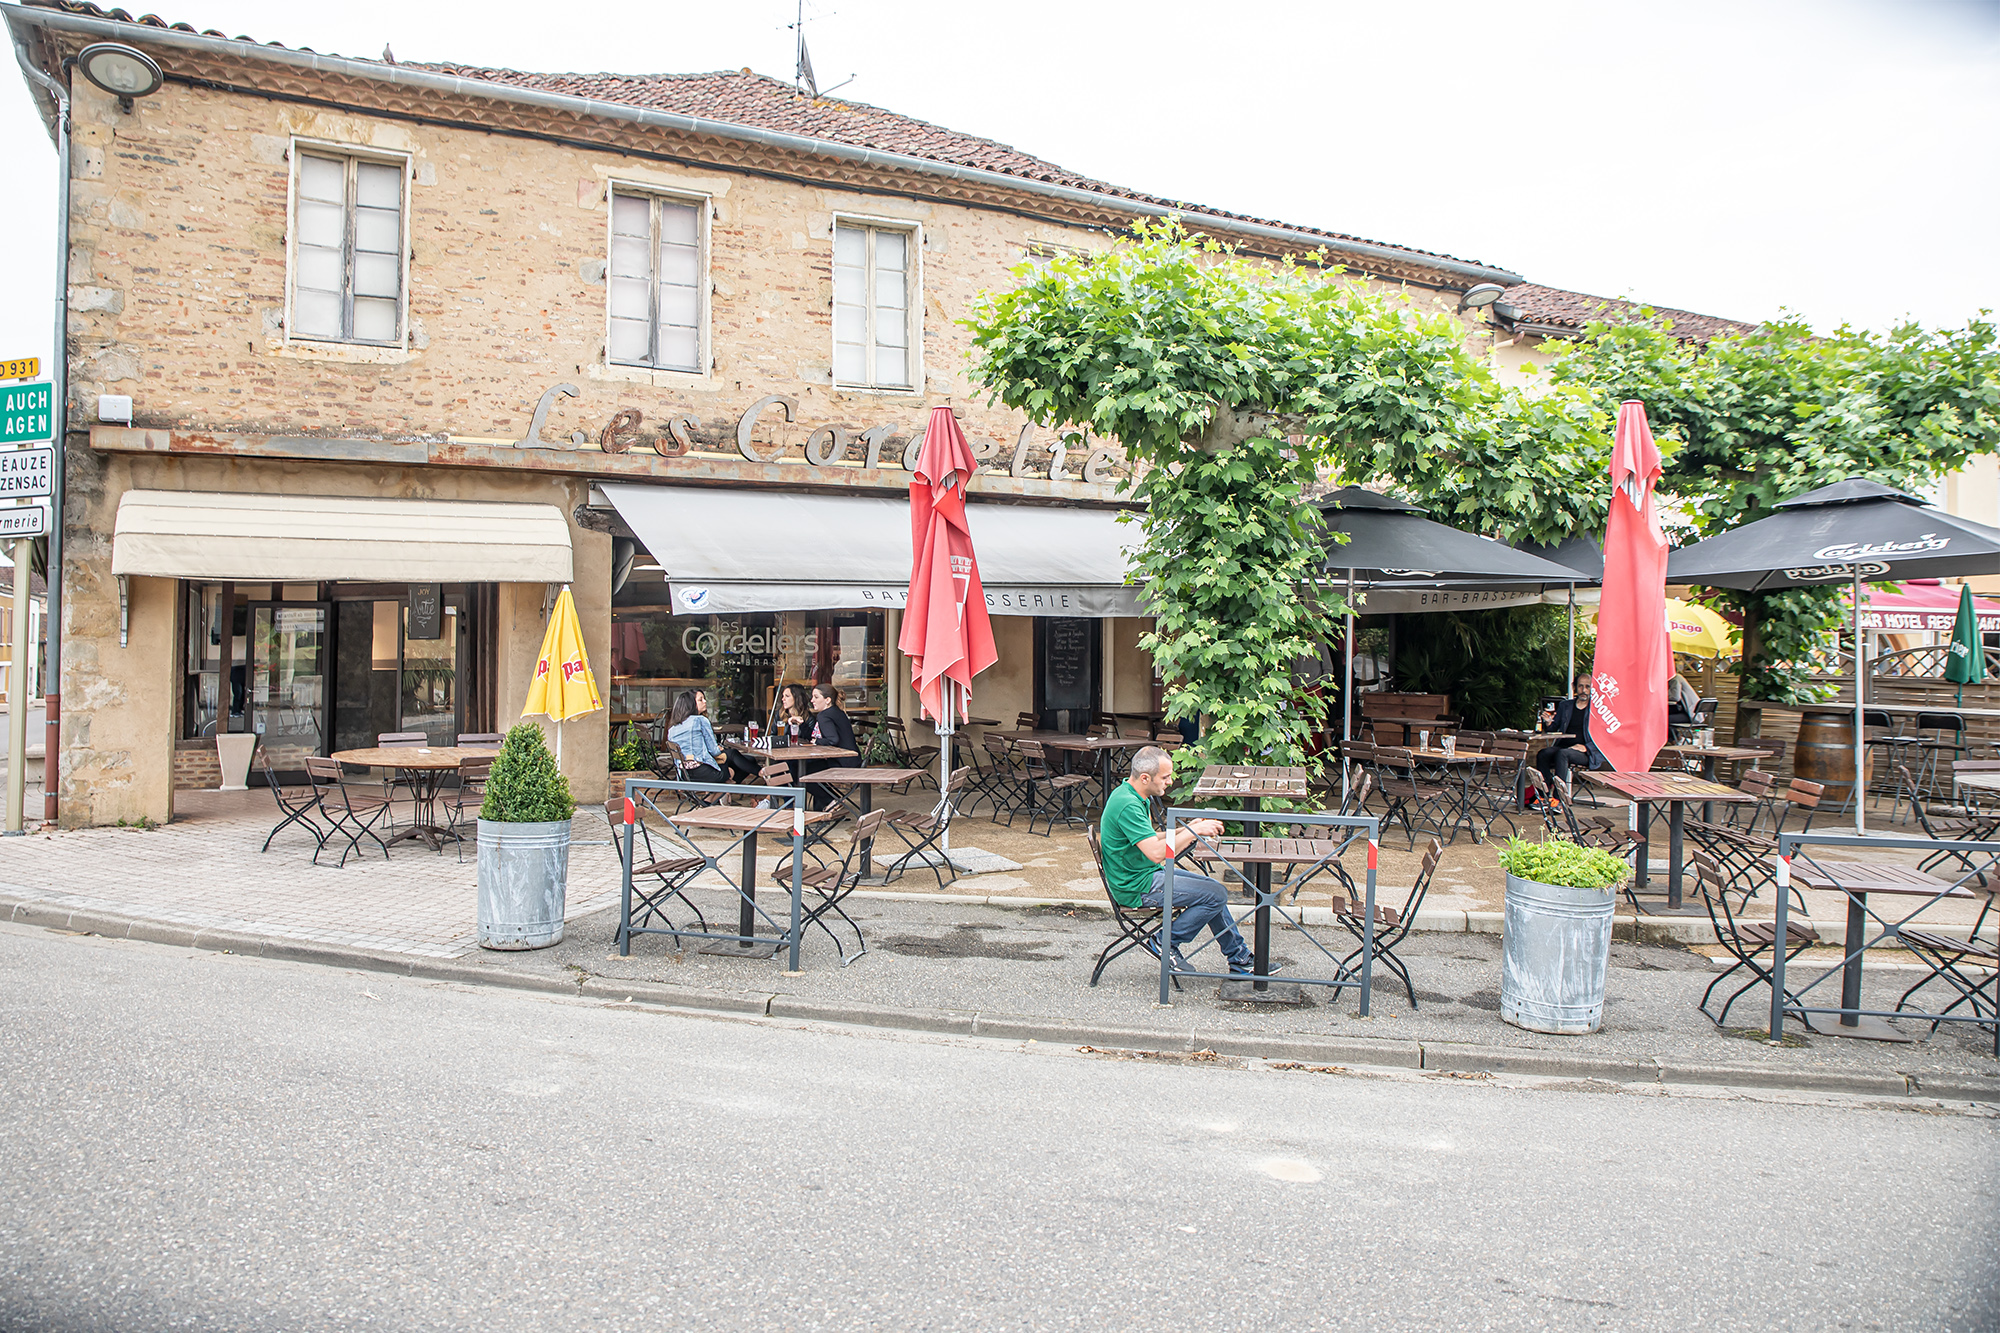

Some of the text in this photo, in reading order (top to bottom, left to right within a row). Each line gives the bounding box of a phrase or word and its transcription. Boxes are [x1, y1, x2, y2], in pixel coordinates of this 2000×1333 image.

[10, 360, 33, 376] 931
[6, 390, 47, 412] AUCH
[5, 414, 47, 435] AGEN
[513, 383, 700, 457] Les
[2, 456, 47, 472] ÉAUZE
[0, 474, 47, 491] ZENSAC
[0, 514, 38, 529] merie
[1813, 536, 1950, 560] Carlsberg
[1670, 621, 1702, 633] pago
[1884, 613, 1925, 629] HOTEL
[682, 626, 819, 660] Cordeliers
